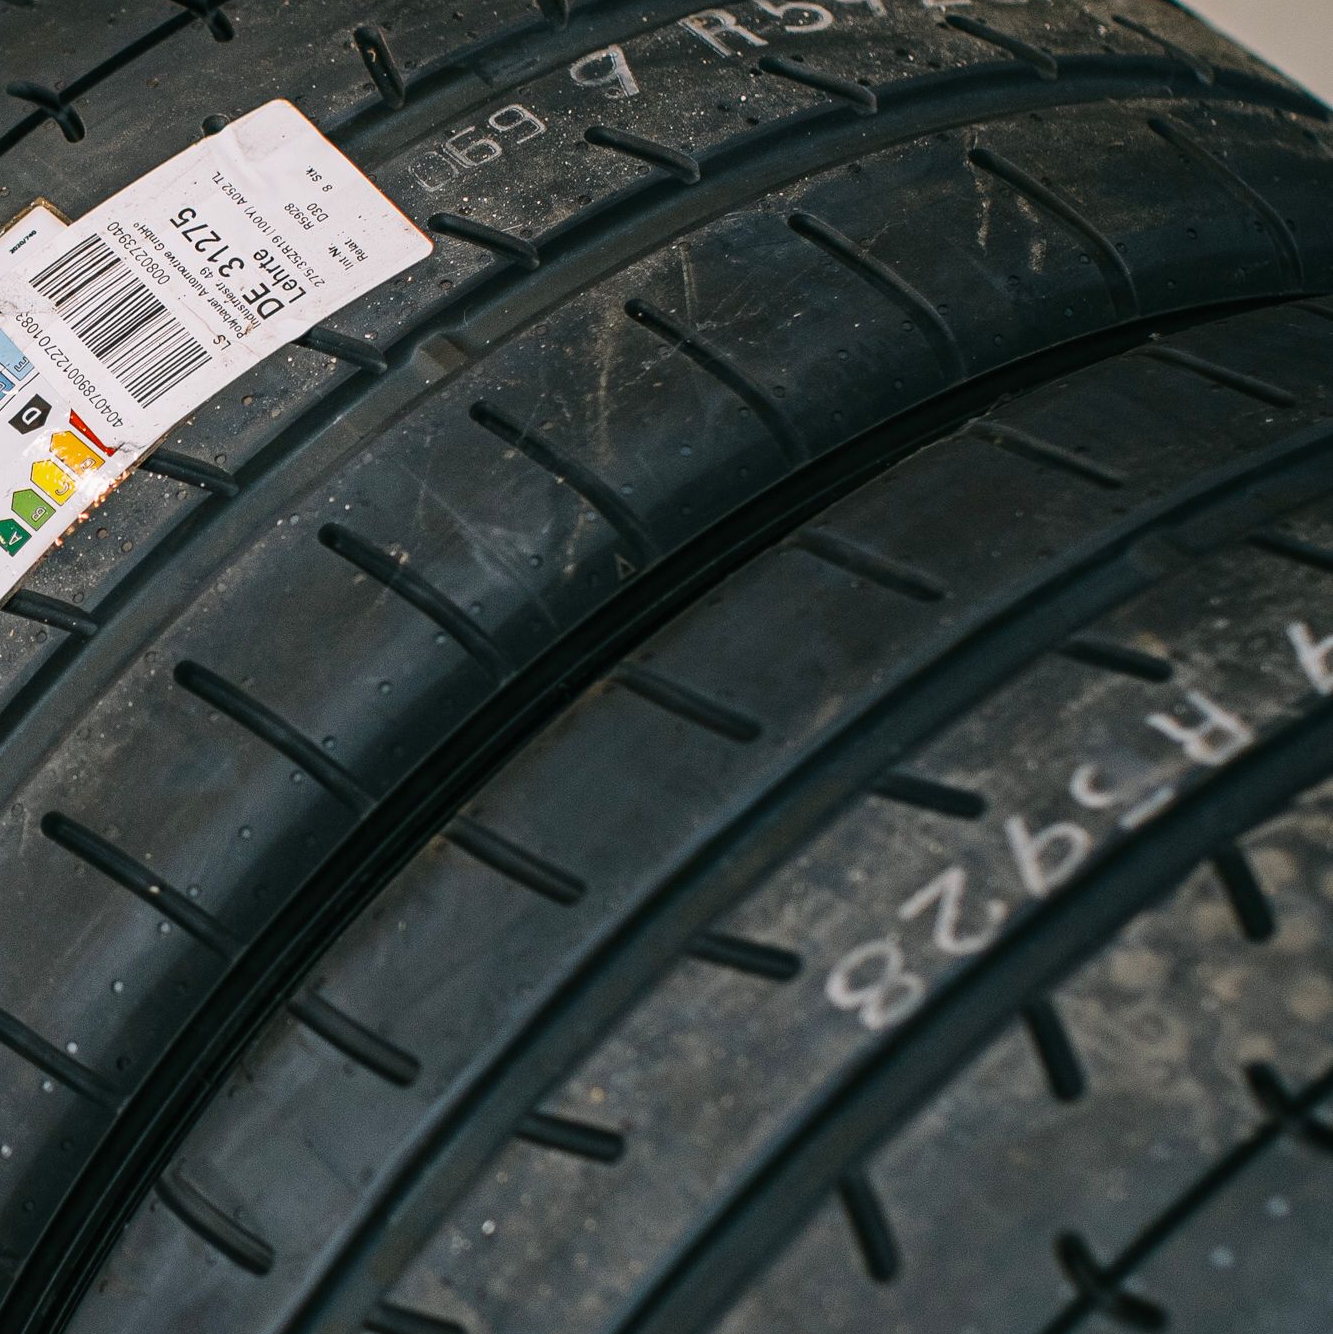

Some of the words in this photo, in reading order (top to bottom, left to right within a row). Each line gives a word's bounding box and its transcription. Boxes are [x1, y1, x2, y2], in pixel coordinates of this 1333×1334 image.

[211, 170, 224, 184] TL
[221, 182, 247, 204] A052
[243, 206, 275, 235] (100Y)
[284, 202, 314, 230] R5928
[306, 202, 328, 222] D30
[106, 221, 170, 284] 0080273940
[169, 207, 244, 277] 31275
[163, 251, 209, 296] Automotive
[199, 266, 213, 278] 49
[253, 248, 306, 303] Lehrte
[241, 282, 284, 319] DE
[212, 334, 231, 350] LS
[824, 690, 1255, 1030] R5928
